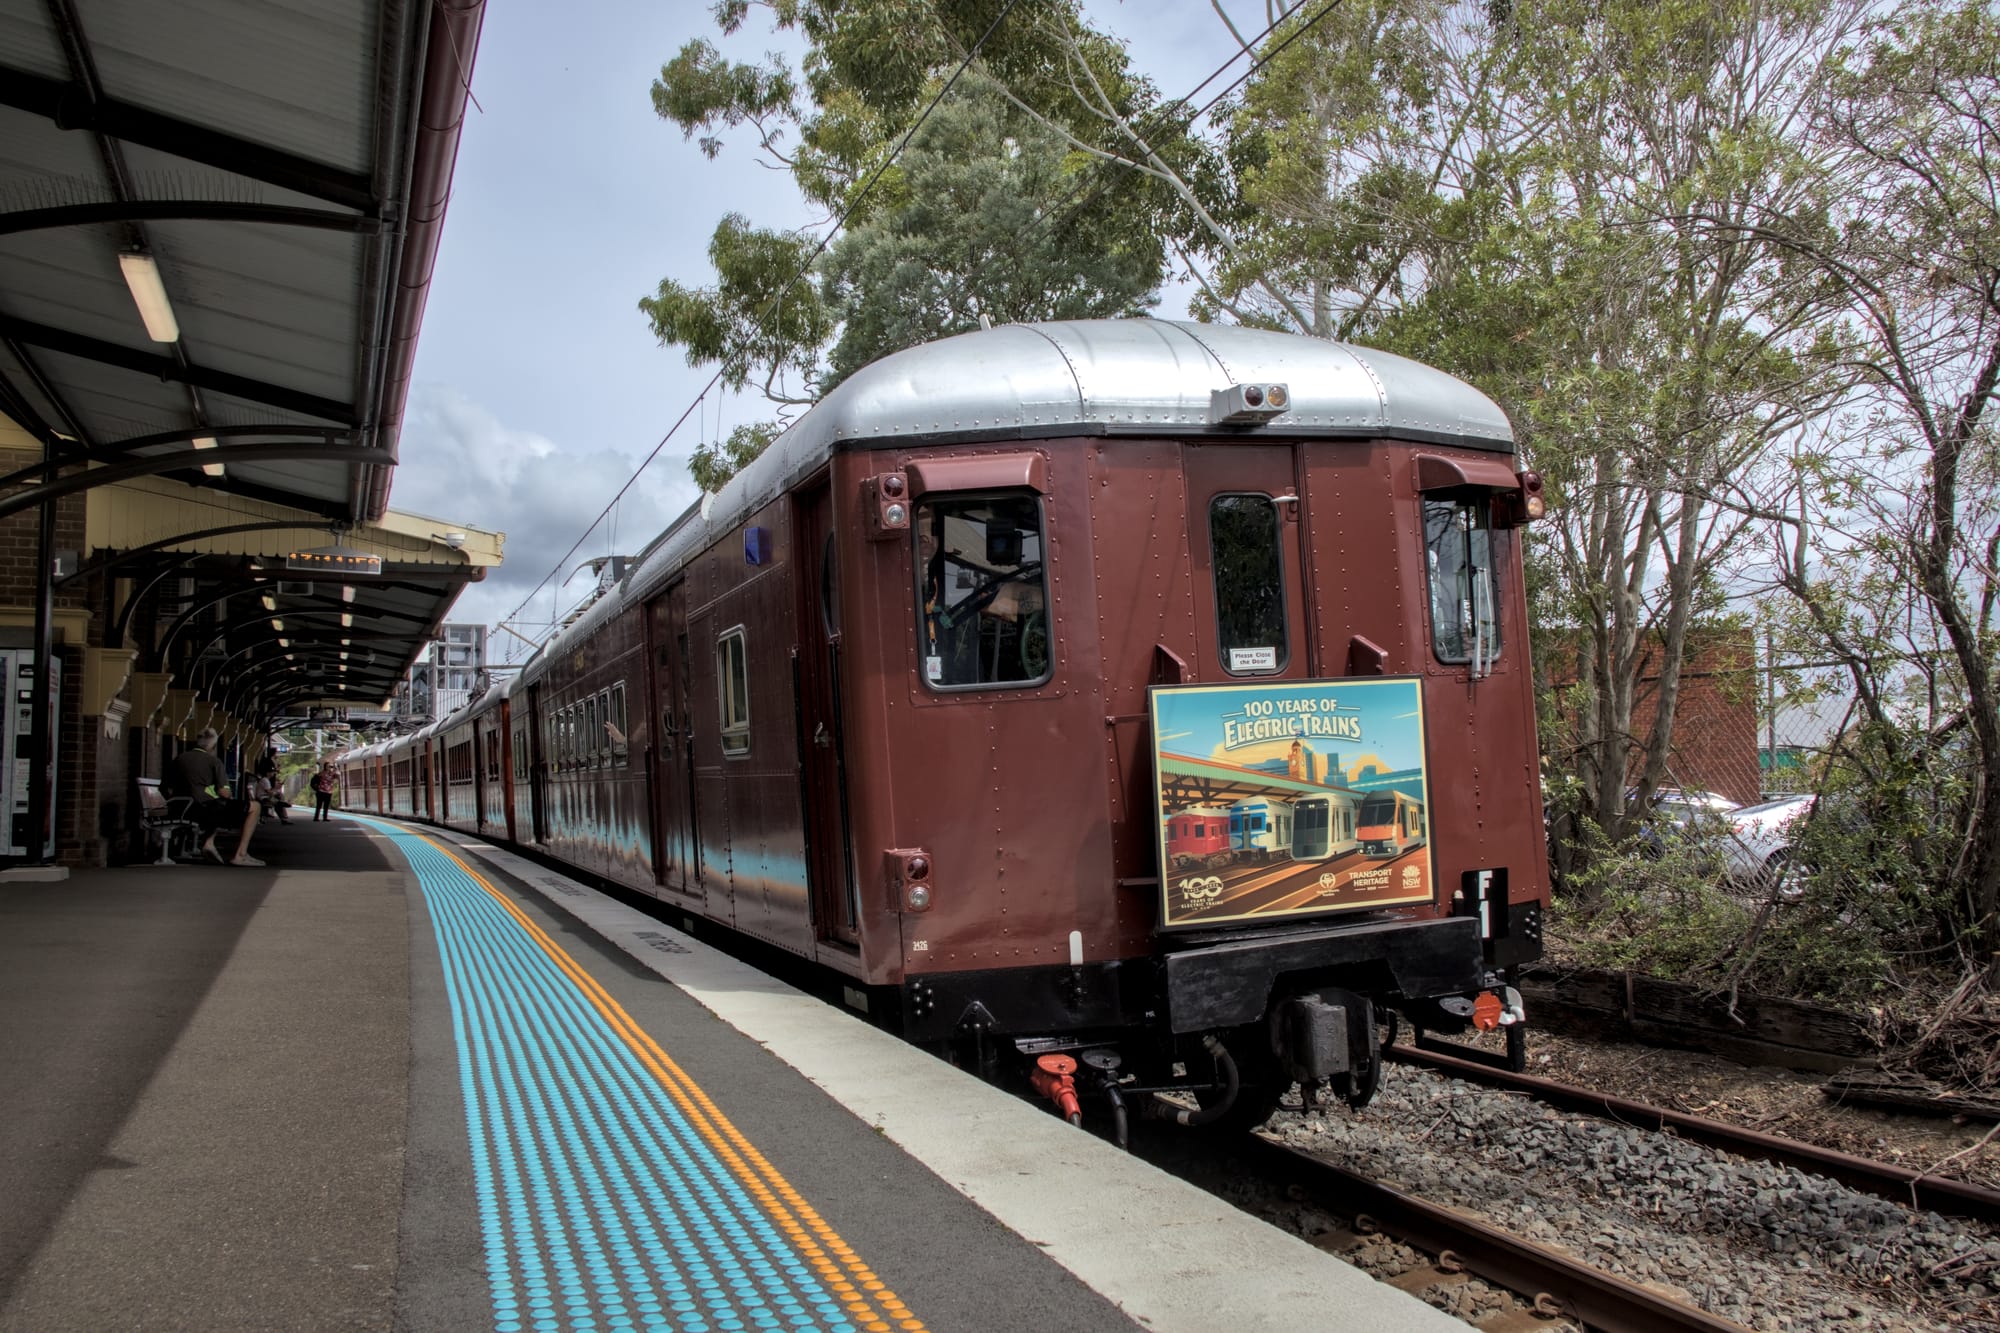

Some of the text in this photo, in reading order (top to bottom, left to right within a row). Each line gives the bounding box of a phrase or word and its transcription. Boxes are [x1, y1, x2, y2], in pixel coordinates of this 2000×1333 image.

[53, 558, 64, 576] 1
[1244, 699, 1337, 717] 100 YEARS OF
[1224, 713, 1361, 748] ELECTRIC TRAINS
[1349, 869, 1392, 880] TRANSPORT
[1353, 876, 1389, 887] HERITAGE
[1402, 877, 1421, 887] NSW
